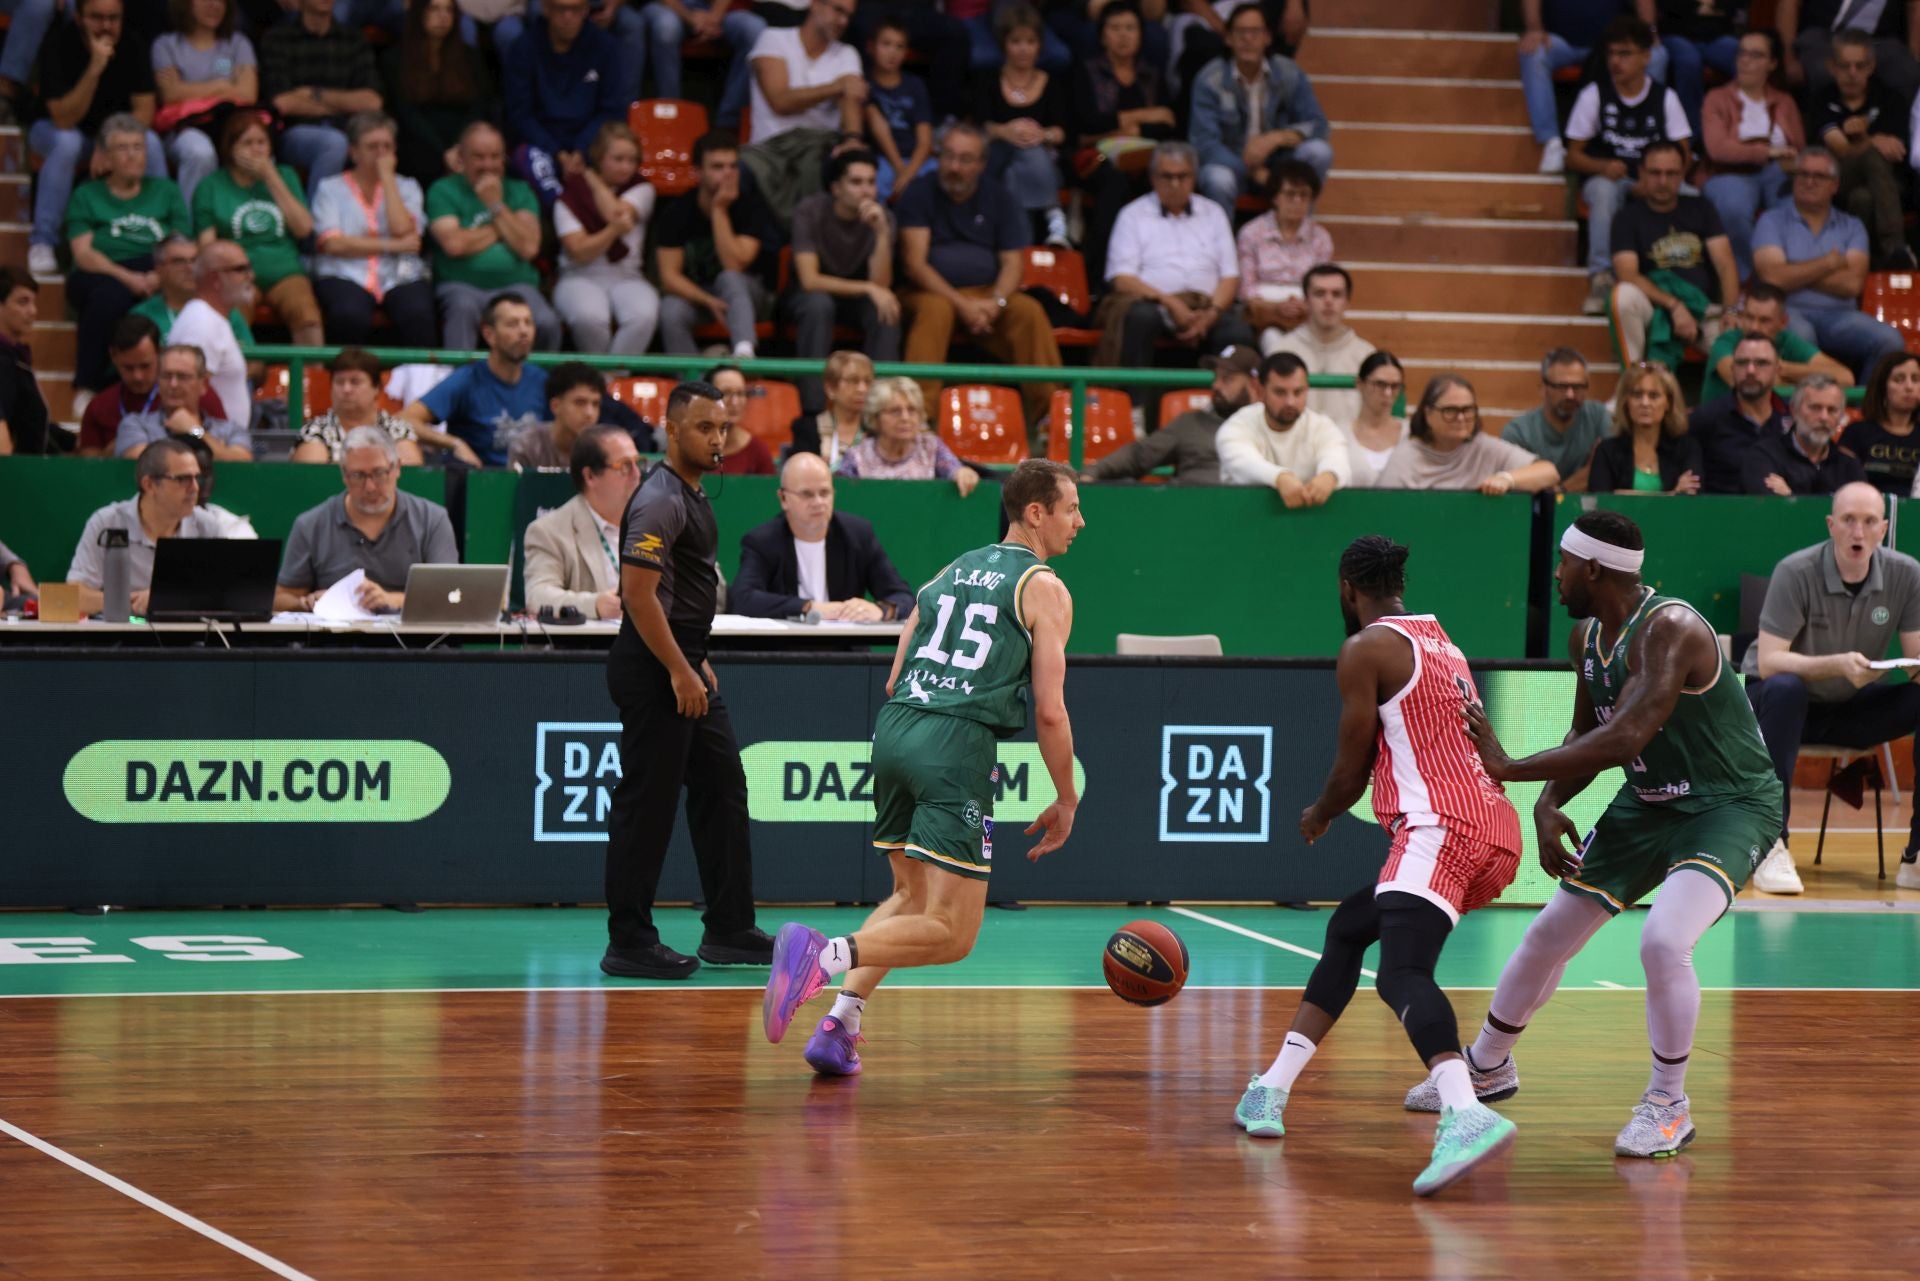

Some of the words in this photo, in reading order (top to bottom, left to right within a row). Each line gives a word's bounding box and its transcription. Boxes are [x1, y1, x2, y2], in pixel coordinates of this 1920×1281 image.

[953, 568, 1006, 590] LANG
[914, 594, 998, 670] 15
[564, 742, 623, 778] DA
[1188, 744, 1247, 780] DA
[126, 759, 391, 803] DAZN.COM
[1186, 787, 1244, 822] ZN
